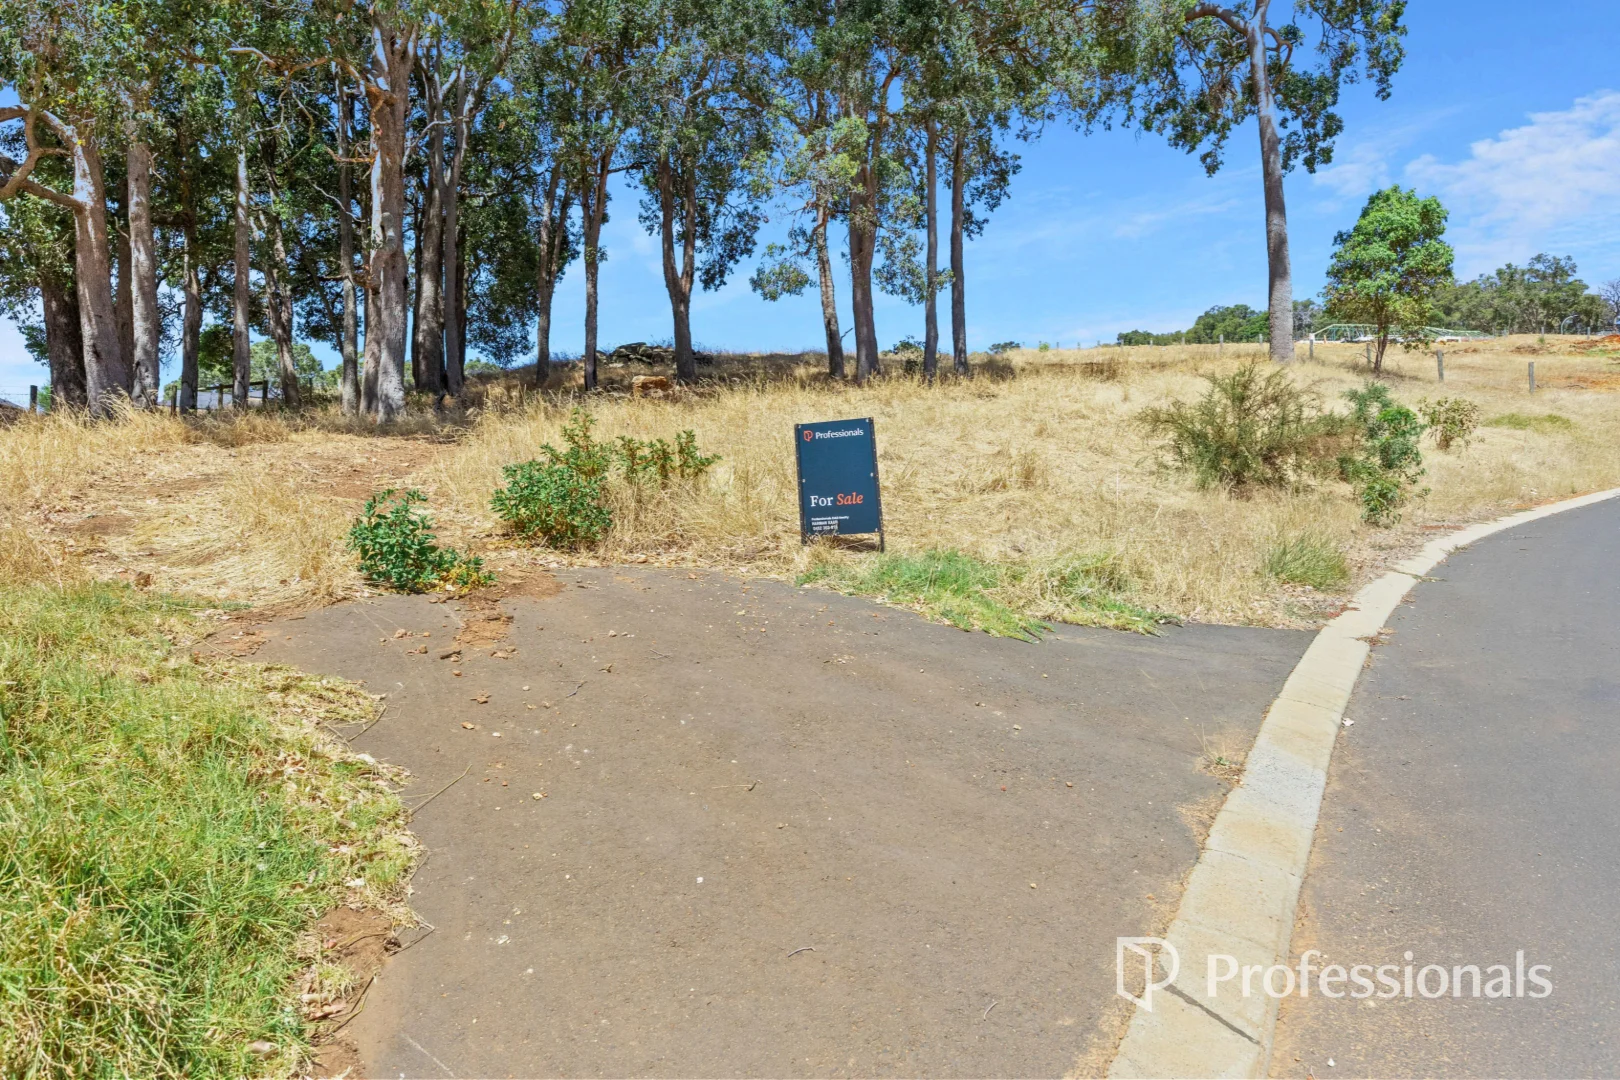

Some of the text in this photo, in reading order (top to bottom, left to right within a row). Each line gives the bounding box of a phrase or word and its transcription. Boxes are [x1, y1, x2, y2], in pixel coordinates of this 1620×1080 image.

[815, 428, 864, 439] Professionals
[810, 492, 864, 507] For Sale
